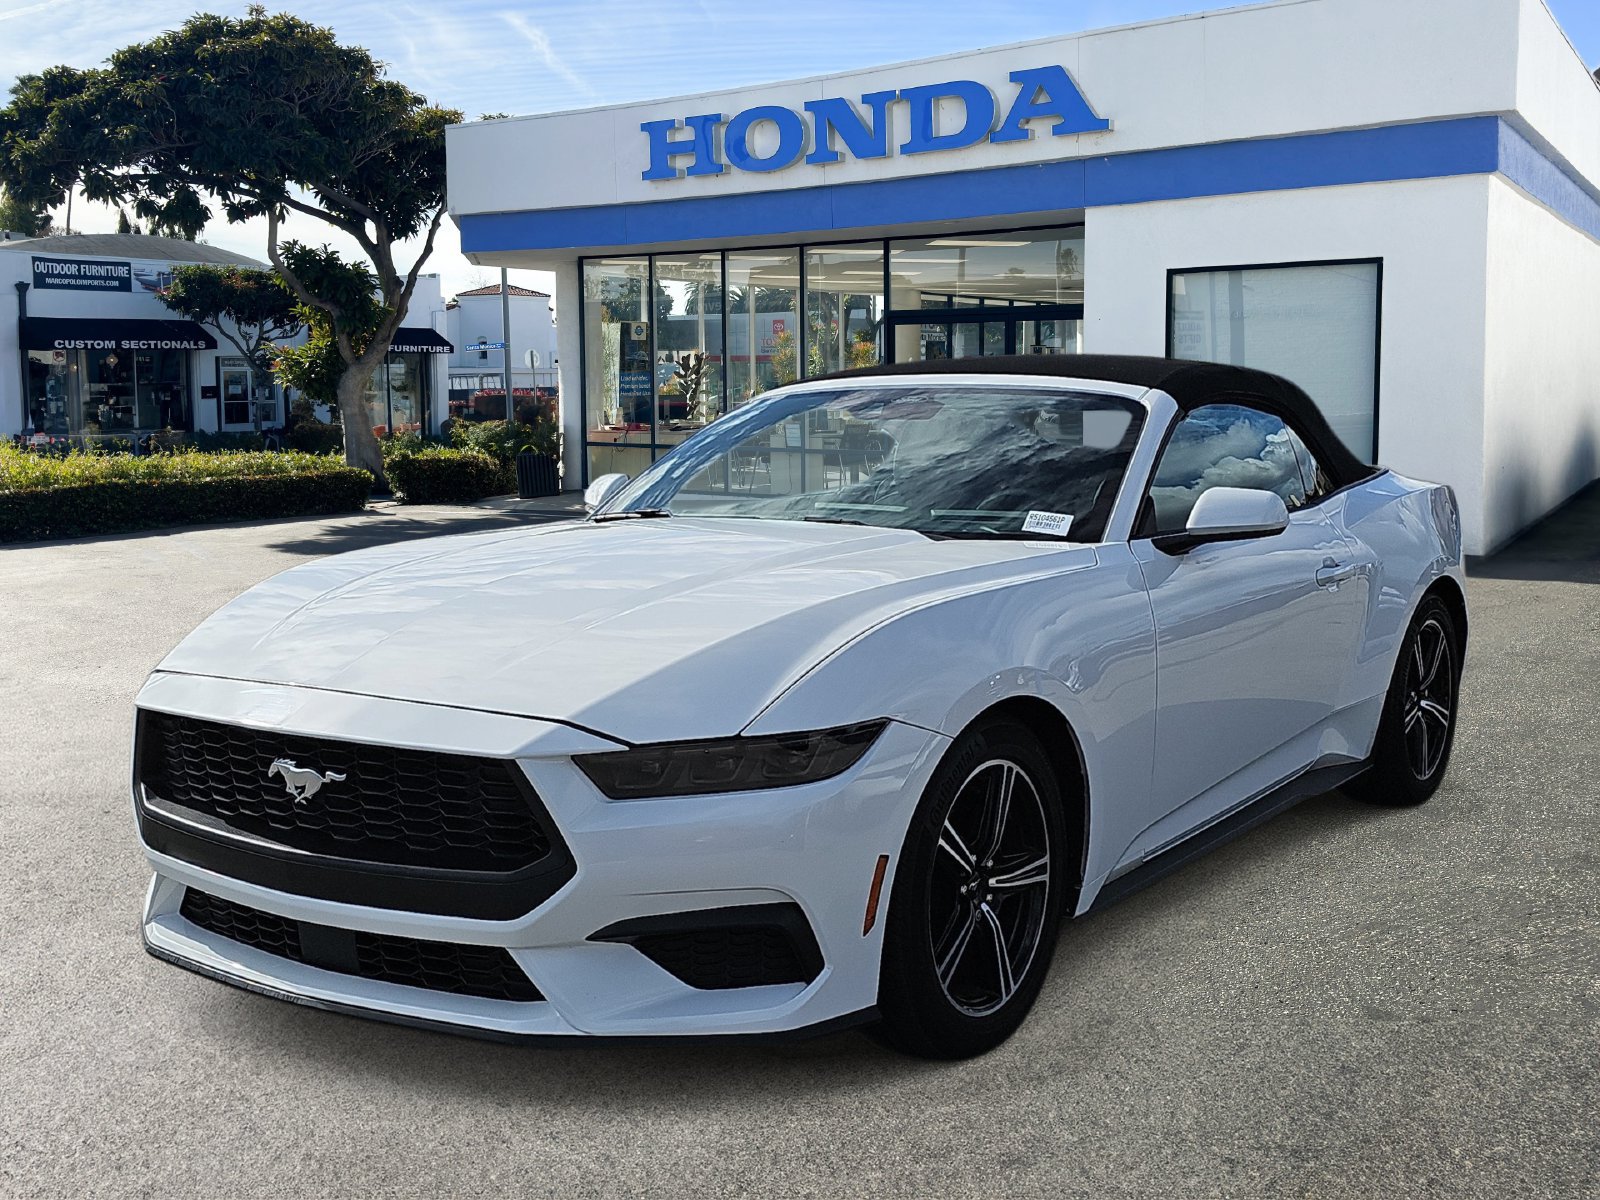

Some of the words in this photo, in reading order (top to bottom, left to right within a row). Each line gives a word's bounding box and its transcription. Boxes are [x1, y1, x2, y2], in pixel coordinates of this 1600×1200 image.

[640, 65, 1112, 181] HONDA
[34, 261, 79, 276] OUTDOOR
[80, 264, 130, 278] FURNITURE
[45, 277, 120, 287] MARCOPOLOIMPORTS.COM
[54, 339, 116, 349] CUSTOM
[121, 340, 206, 349] SECTIONALS
[388, 344, 451, 353] FURNITURE
